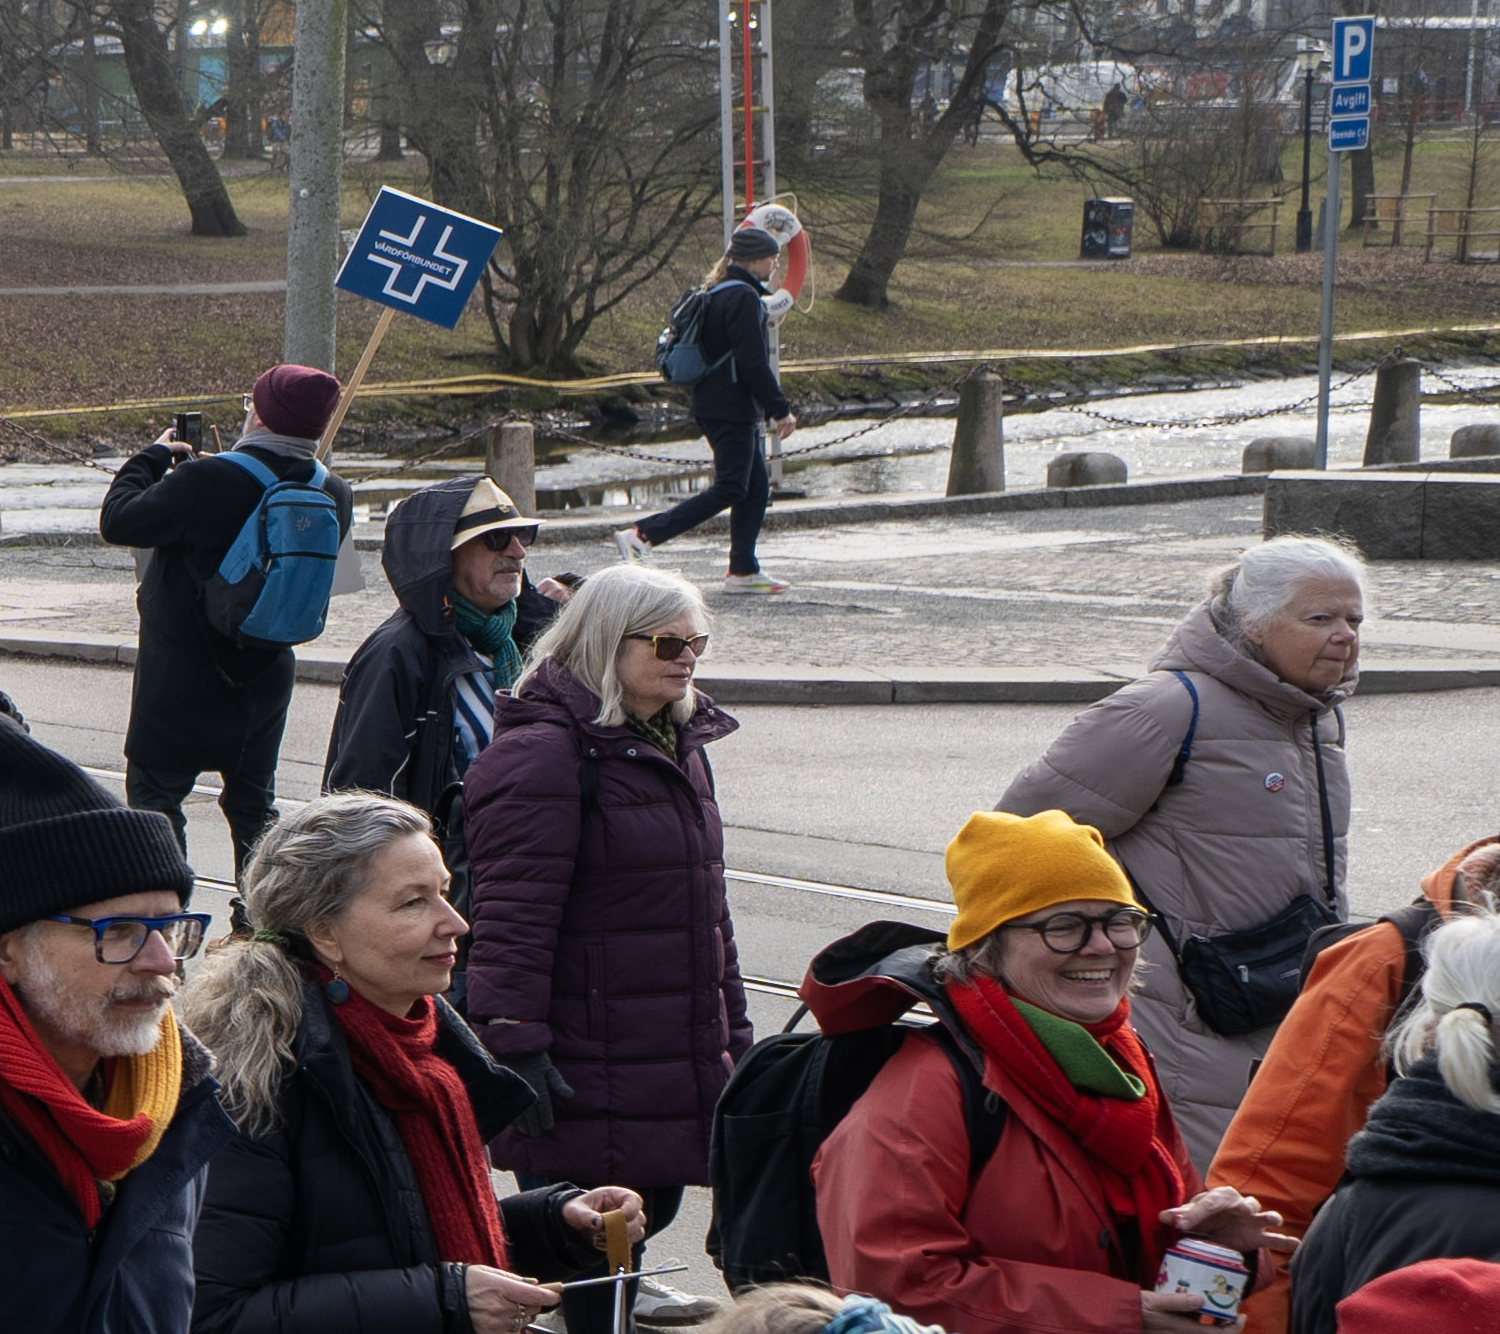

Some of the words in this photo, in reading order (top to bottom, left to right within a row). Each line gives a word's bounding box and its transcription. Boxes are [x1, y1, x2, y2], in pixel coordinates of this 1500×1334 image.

[1343, 25, 1366, 77] P
[1335, 93, 1366, 109] Avgift
[374, 240, 453, 276] VÅRDFÖRBUNDET
